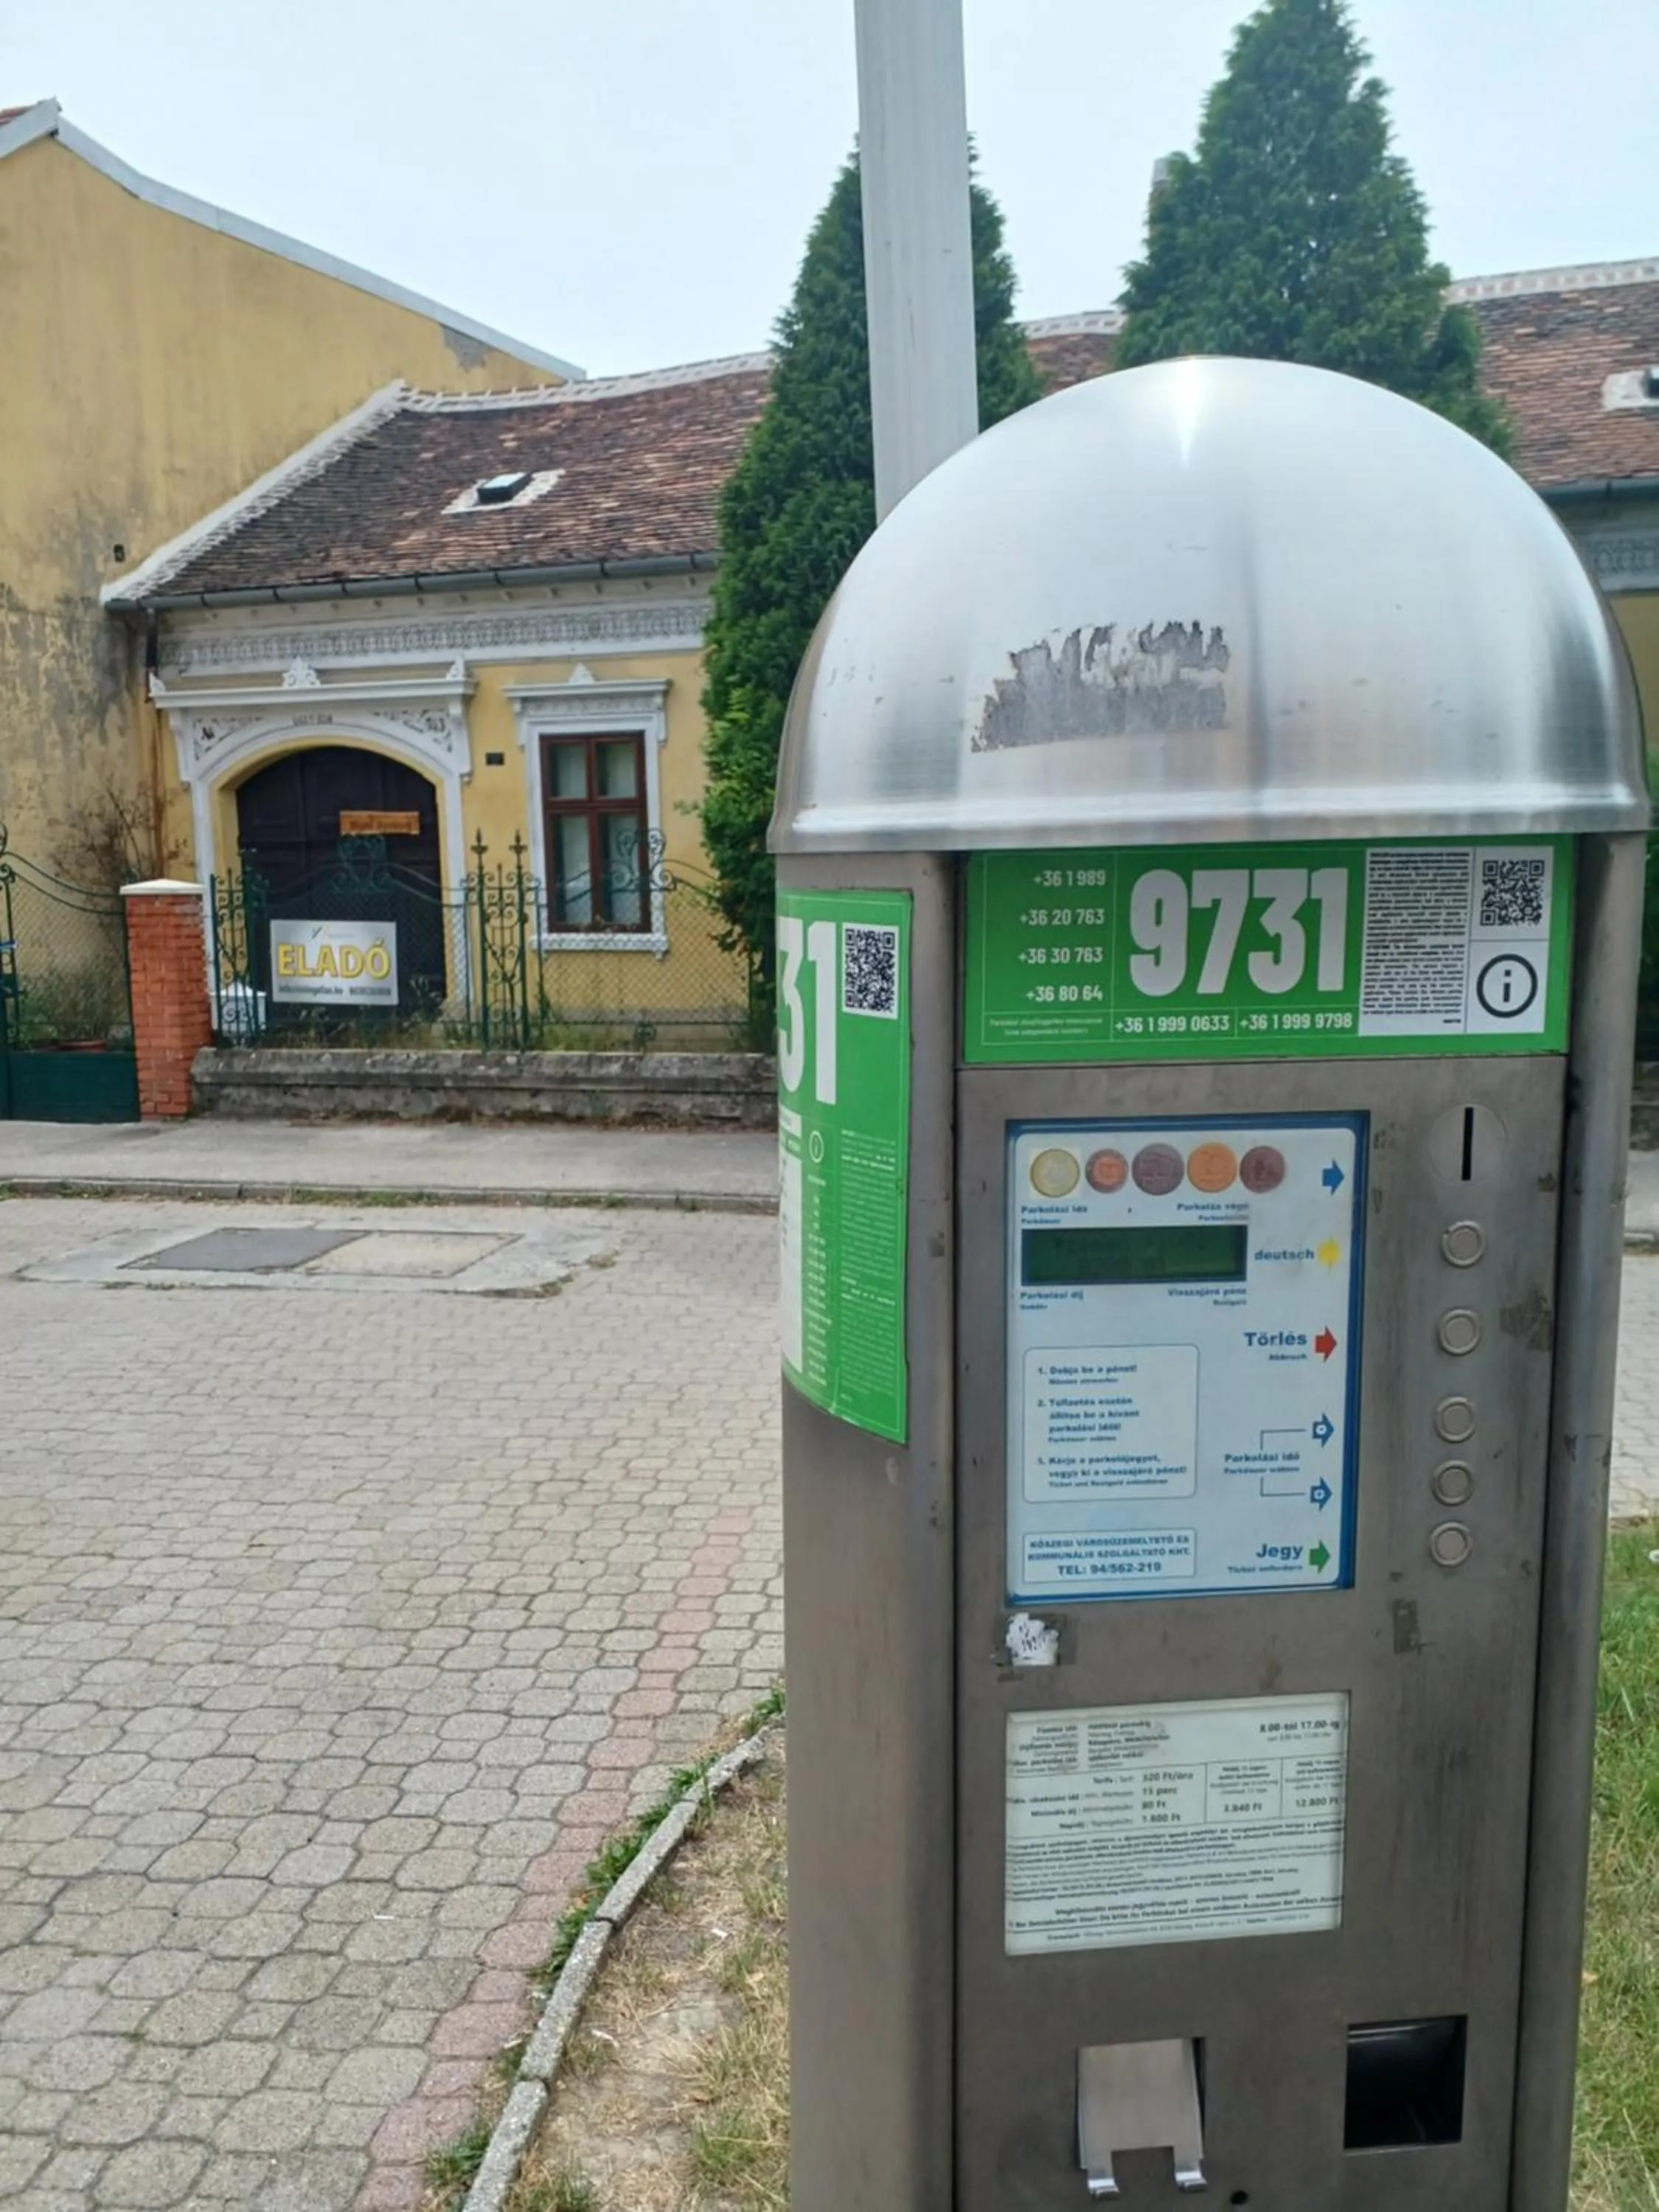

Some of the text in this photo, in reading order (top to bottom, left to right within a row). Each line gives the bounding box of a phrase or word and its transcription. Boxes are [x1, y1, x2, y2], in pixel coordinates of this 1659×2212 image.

[1034, 870, 1062, 887] +36
[1020, 908, 1105, 925] +36 20 763
[1130, 868, 1348, 997] 9731
[278, 936, 391, 980] ELADÓ
[1018, 947, 1104, 964] +36 30 763
[1026, 984, 1103, 1001] +36 80 64
[1115, 1017, 1142, 1032] +36
[1158, 1016, 1186, 1032] 999
[1191, 1015, 1229, 1030] 0633
[1239, 1015, 1267, 1030] +36
[1282, 1014, 1310, 1029] 999
[1315, 1012, 1353, 1029] 9798
[1255, 1249, 1315, 1260] deutsch
[1244, 1331, 1307, 1346] Törlés
[1256, 1543, 1303, 1560] Jegy
[1057, 1565, 1086, 1576] TEL:
